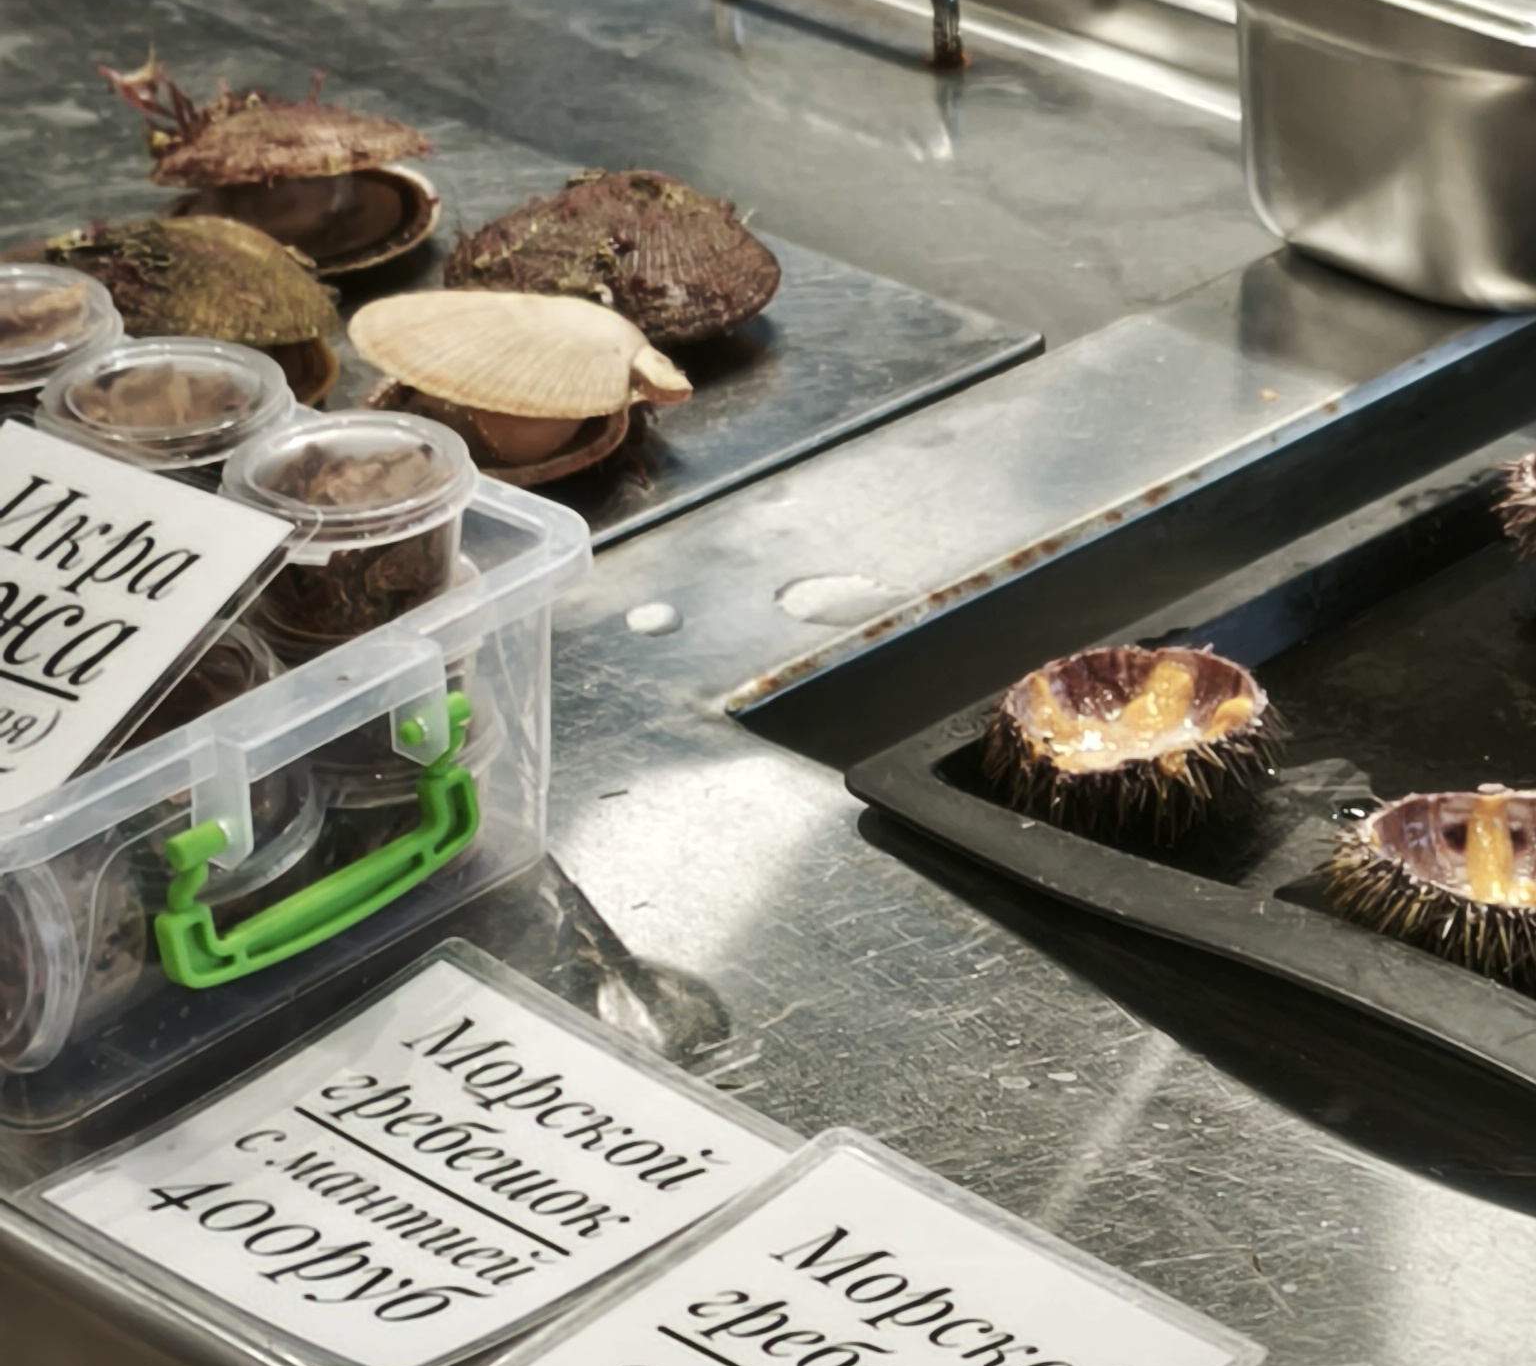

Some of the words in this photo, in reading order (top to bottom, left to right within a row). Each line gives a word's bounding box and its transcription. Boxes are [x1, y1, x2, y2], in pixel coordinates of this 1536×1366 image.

[0, 475, 204, 601] Икра
[0, 581, 141, 687] жа
[320, 1069, 631, 1239] гребешок
[401, 1016, 732, 1193] Морской
[148, 1179, 499, 1324] 400руб
[266, 1143, 566, 1288] мантией
